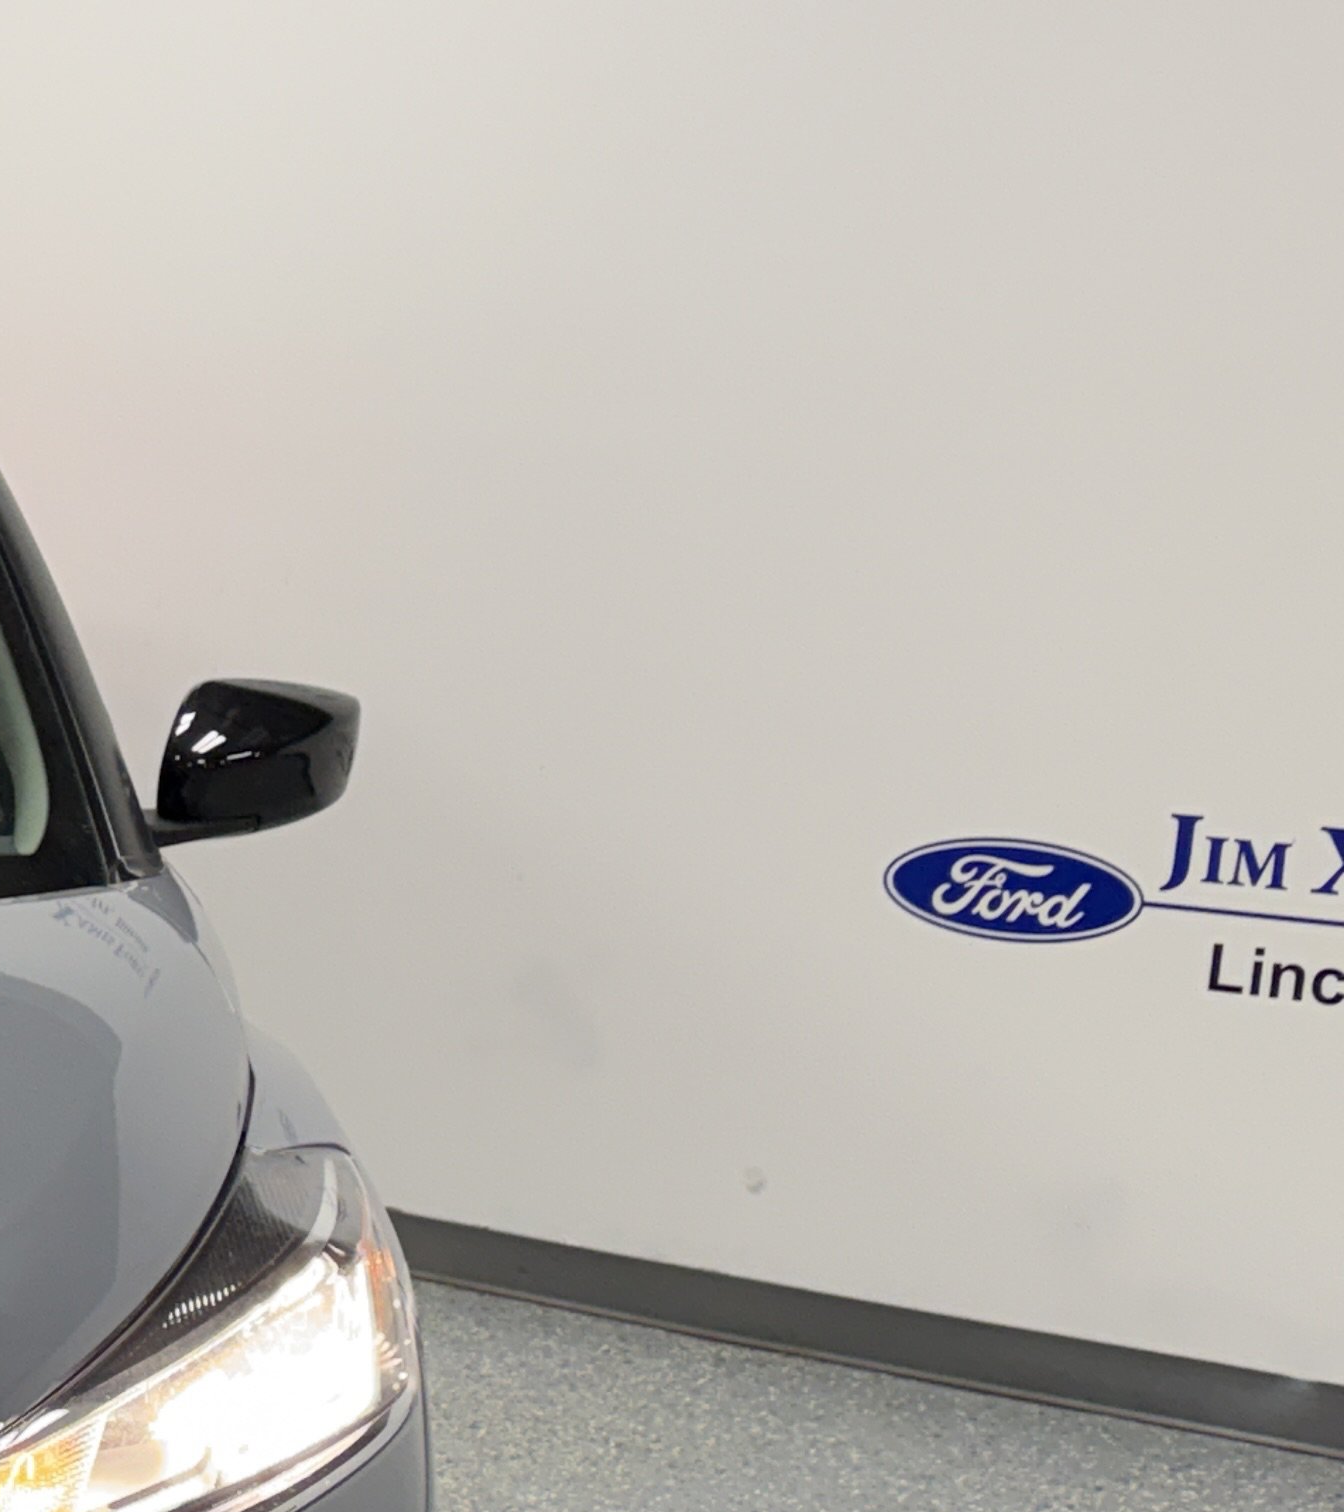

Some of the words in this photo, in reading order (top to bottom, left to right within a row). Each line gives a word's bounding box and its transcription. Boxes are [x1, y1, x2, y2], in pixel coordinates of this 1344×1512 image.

[1159, 813, 1294, 892] JIM
[932, 854, 1091, 930] Ford
[1208, 943, 1344, 1006] Linc
